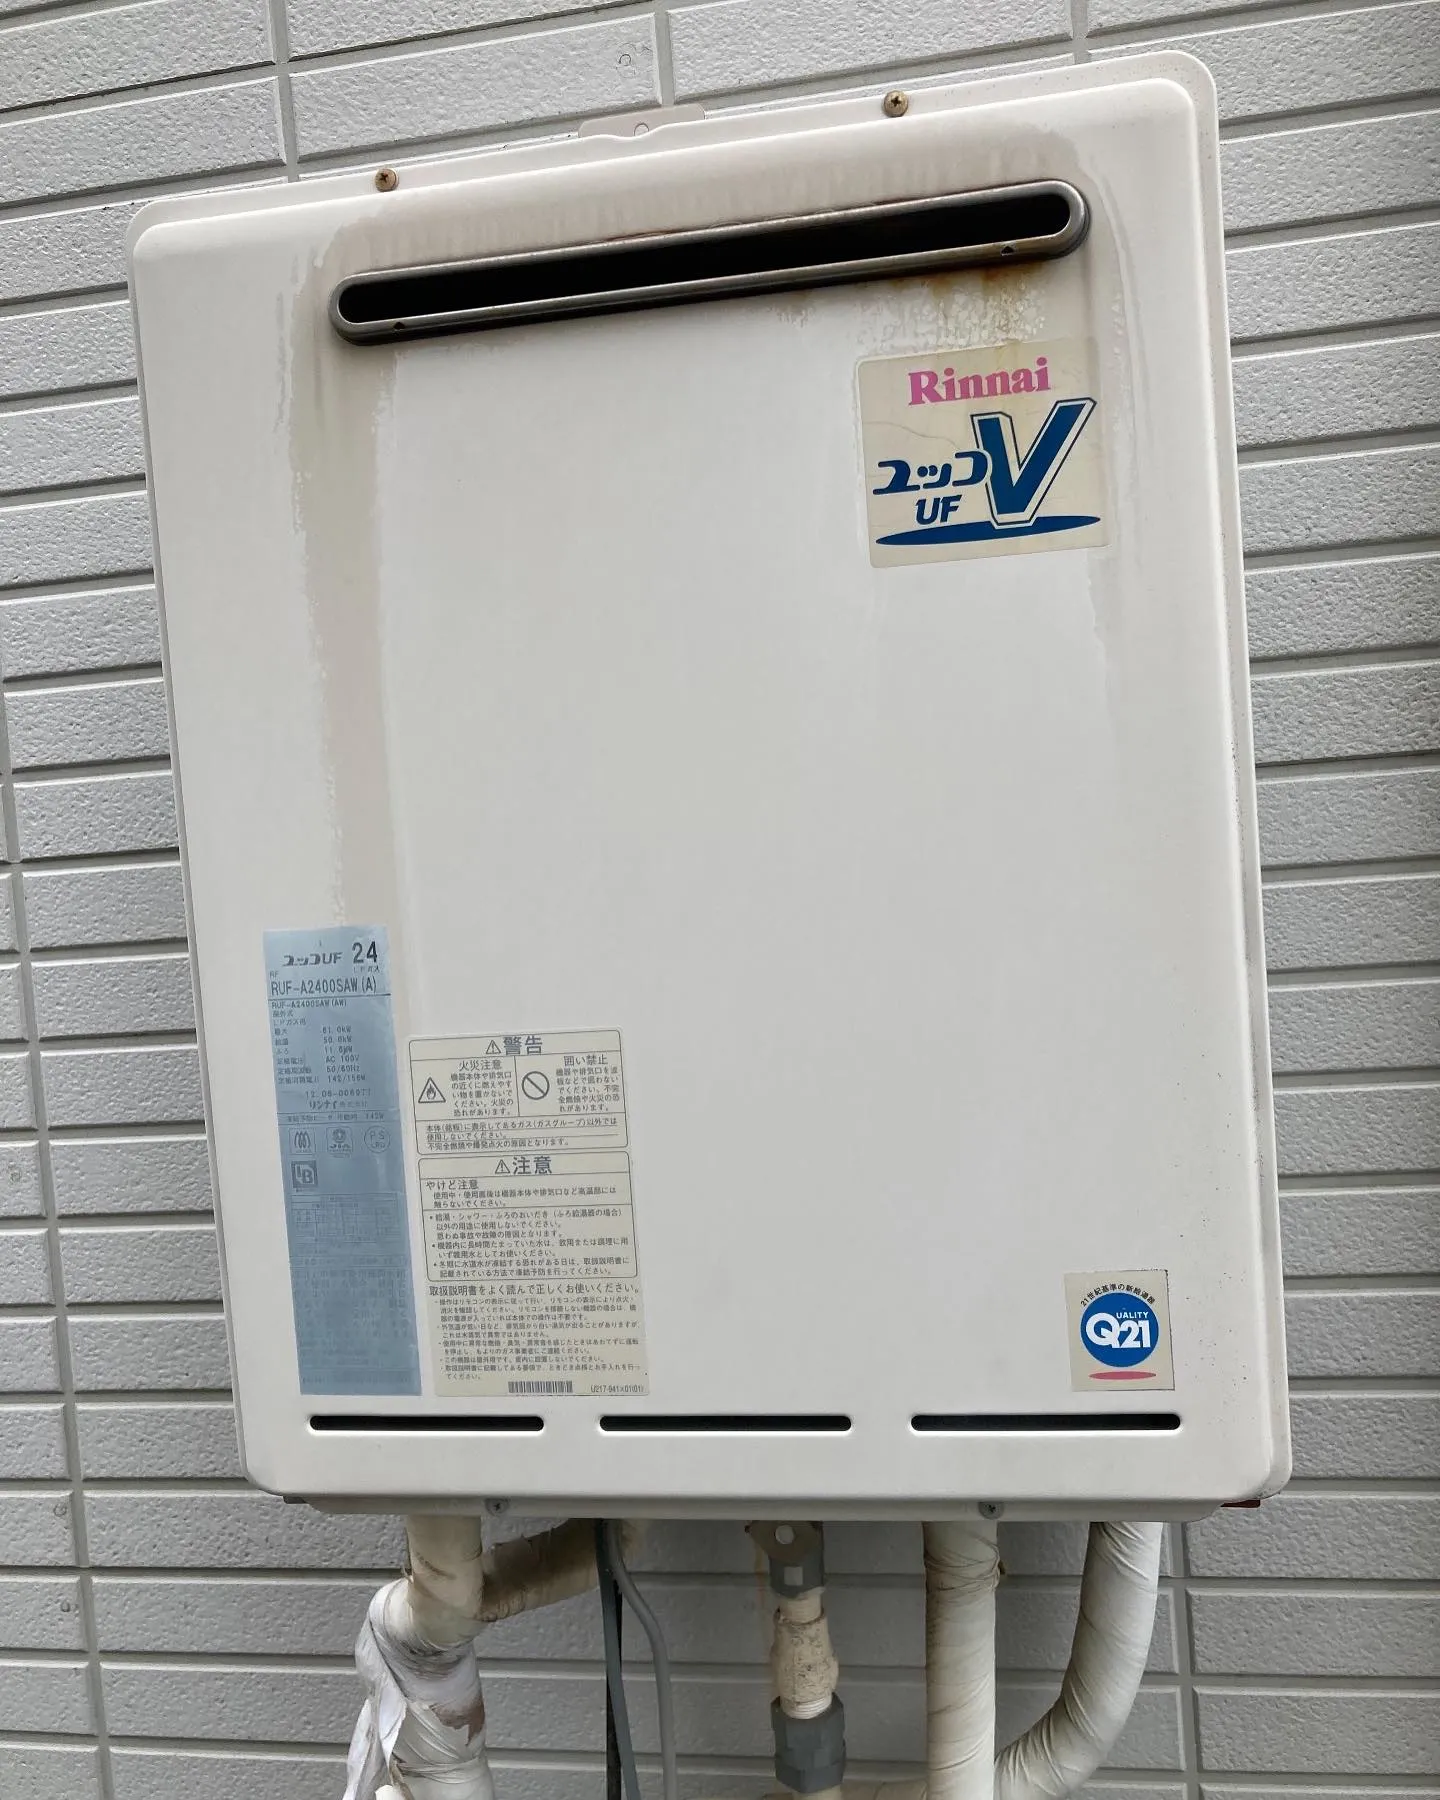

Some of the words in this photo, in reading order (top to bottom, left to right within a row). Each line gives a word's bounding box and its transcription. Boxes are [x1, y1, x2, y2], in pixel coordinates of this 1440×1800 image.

[908, 357, 1051, 406] Rinnai
[873, 450, 990, 495] ユッコ
[970, 397, 1097, 526] V
[915, 494, 962, 525] UF
[352, 941, 378, 964] 24
[503, 1036, 543, 1055] 警告
[459, 1060, 502, 1071] 火災注意
[564, 1054, 608, 1067] 囲い禁止
[513, 1156, 552, 1174] 注意
[426, 1180, 479, 1190] やけど注意
[1116, 1311, 1149, 1319] UALITY
[1086, 1312, 1151, 1348] Q21
